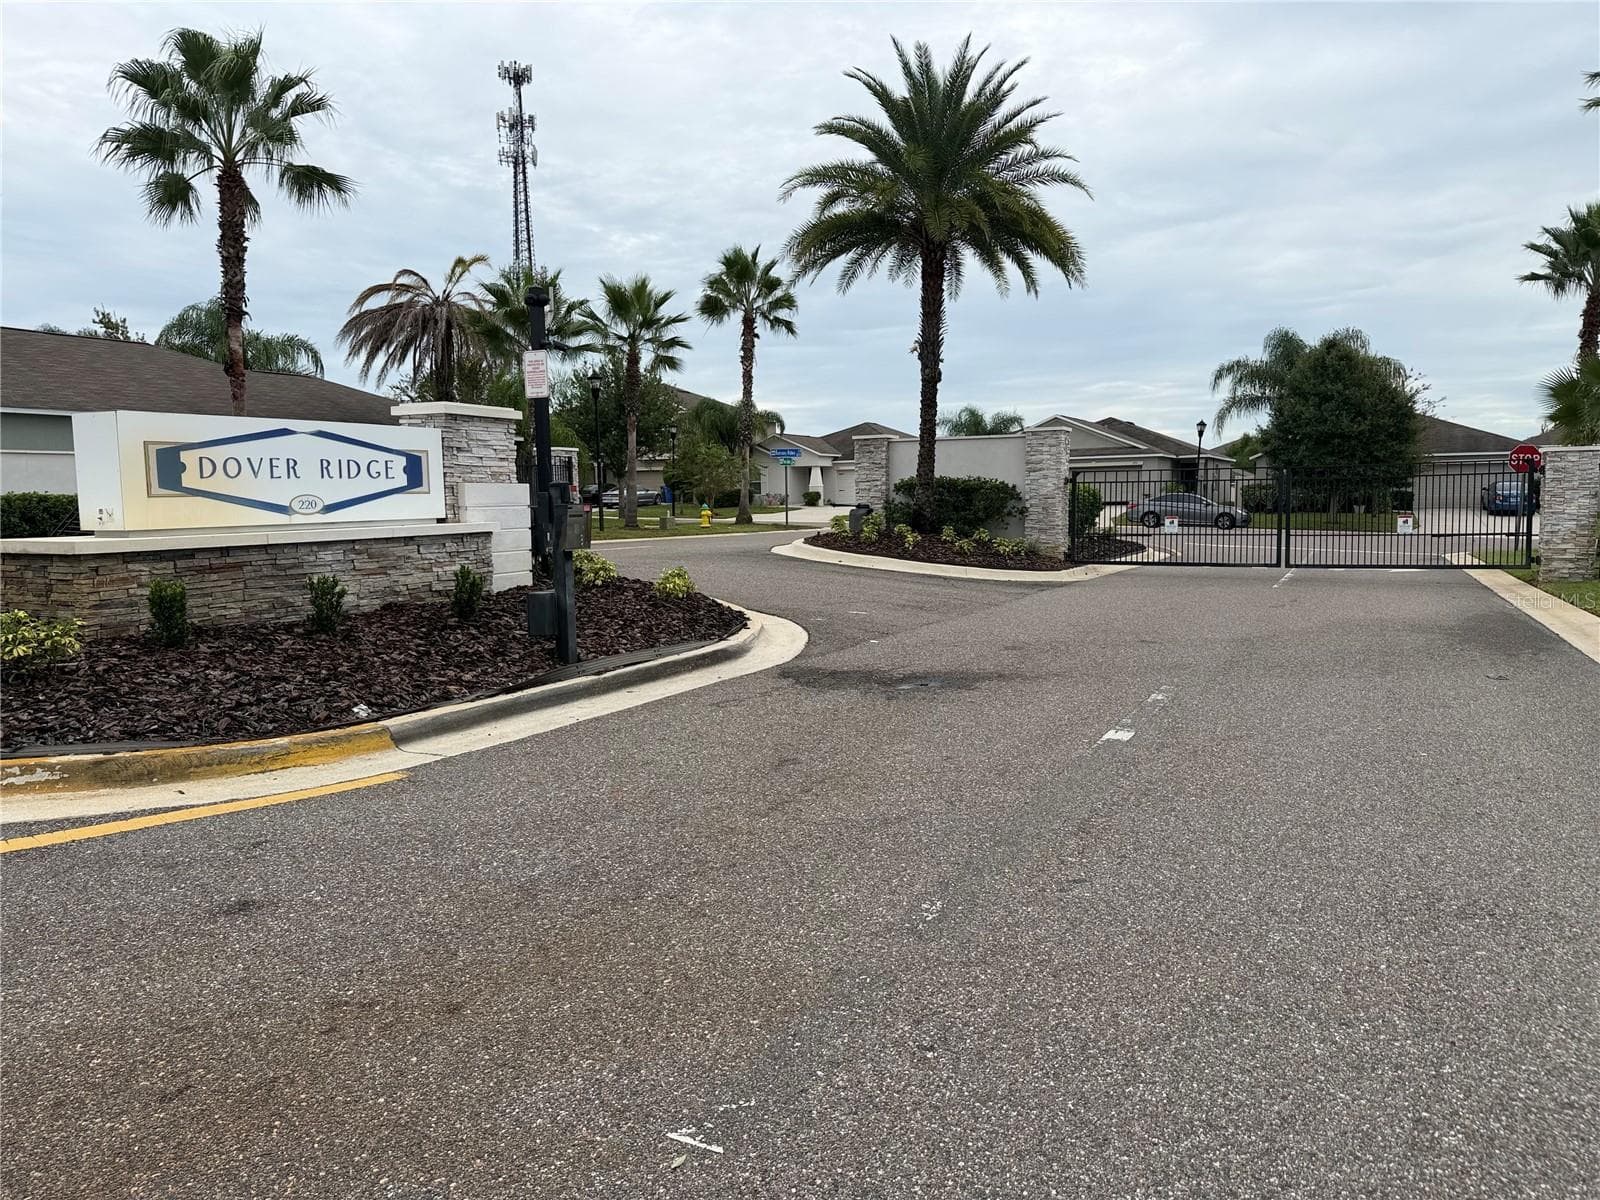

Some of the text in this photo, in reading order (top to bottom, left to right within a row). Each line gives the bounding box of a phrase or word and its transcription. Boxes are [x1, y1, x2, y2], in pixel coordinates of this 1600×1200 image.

[198, 456, 396, 480] DOVER RIDGE
[298, 499, 318, 510] 220
